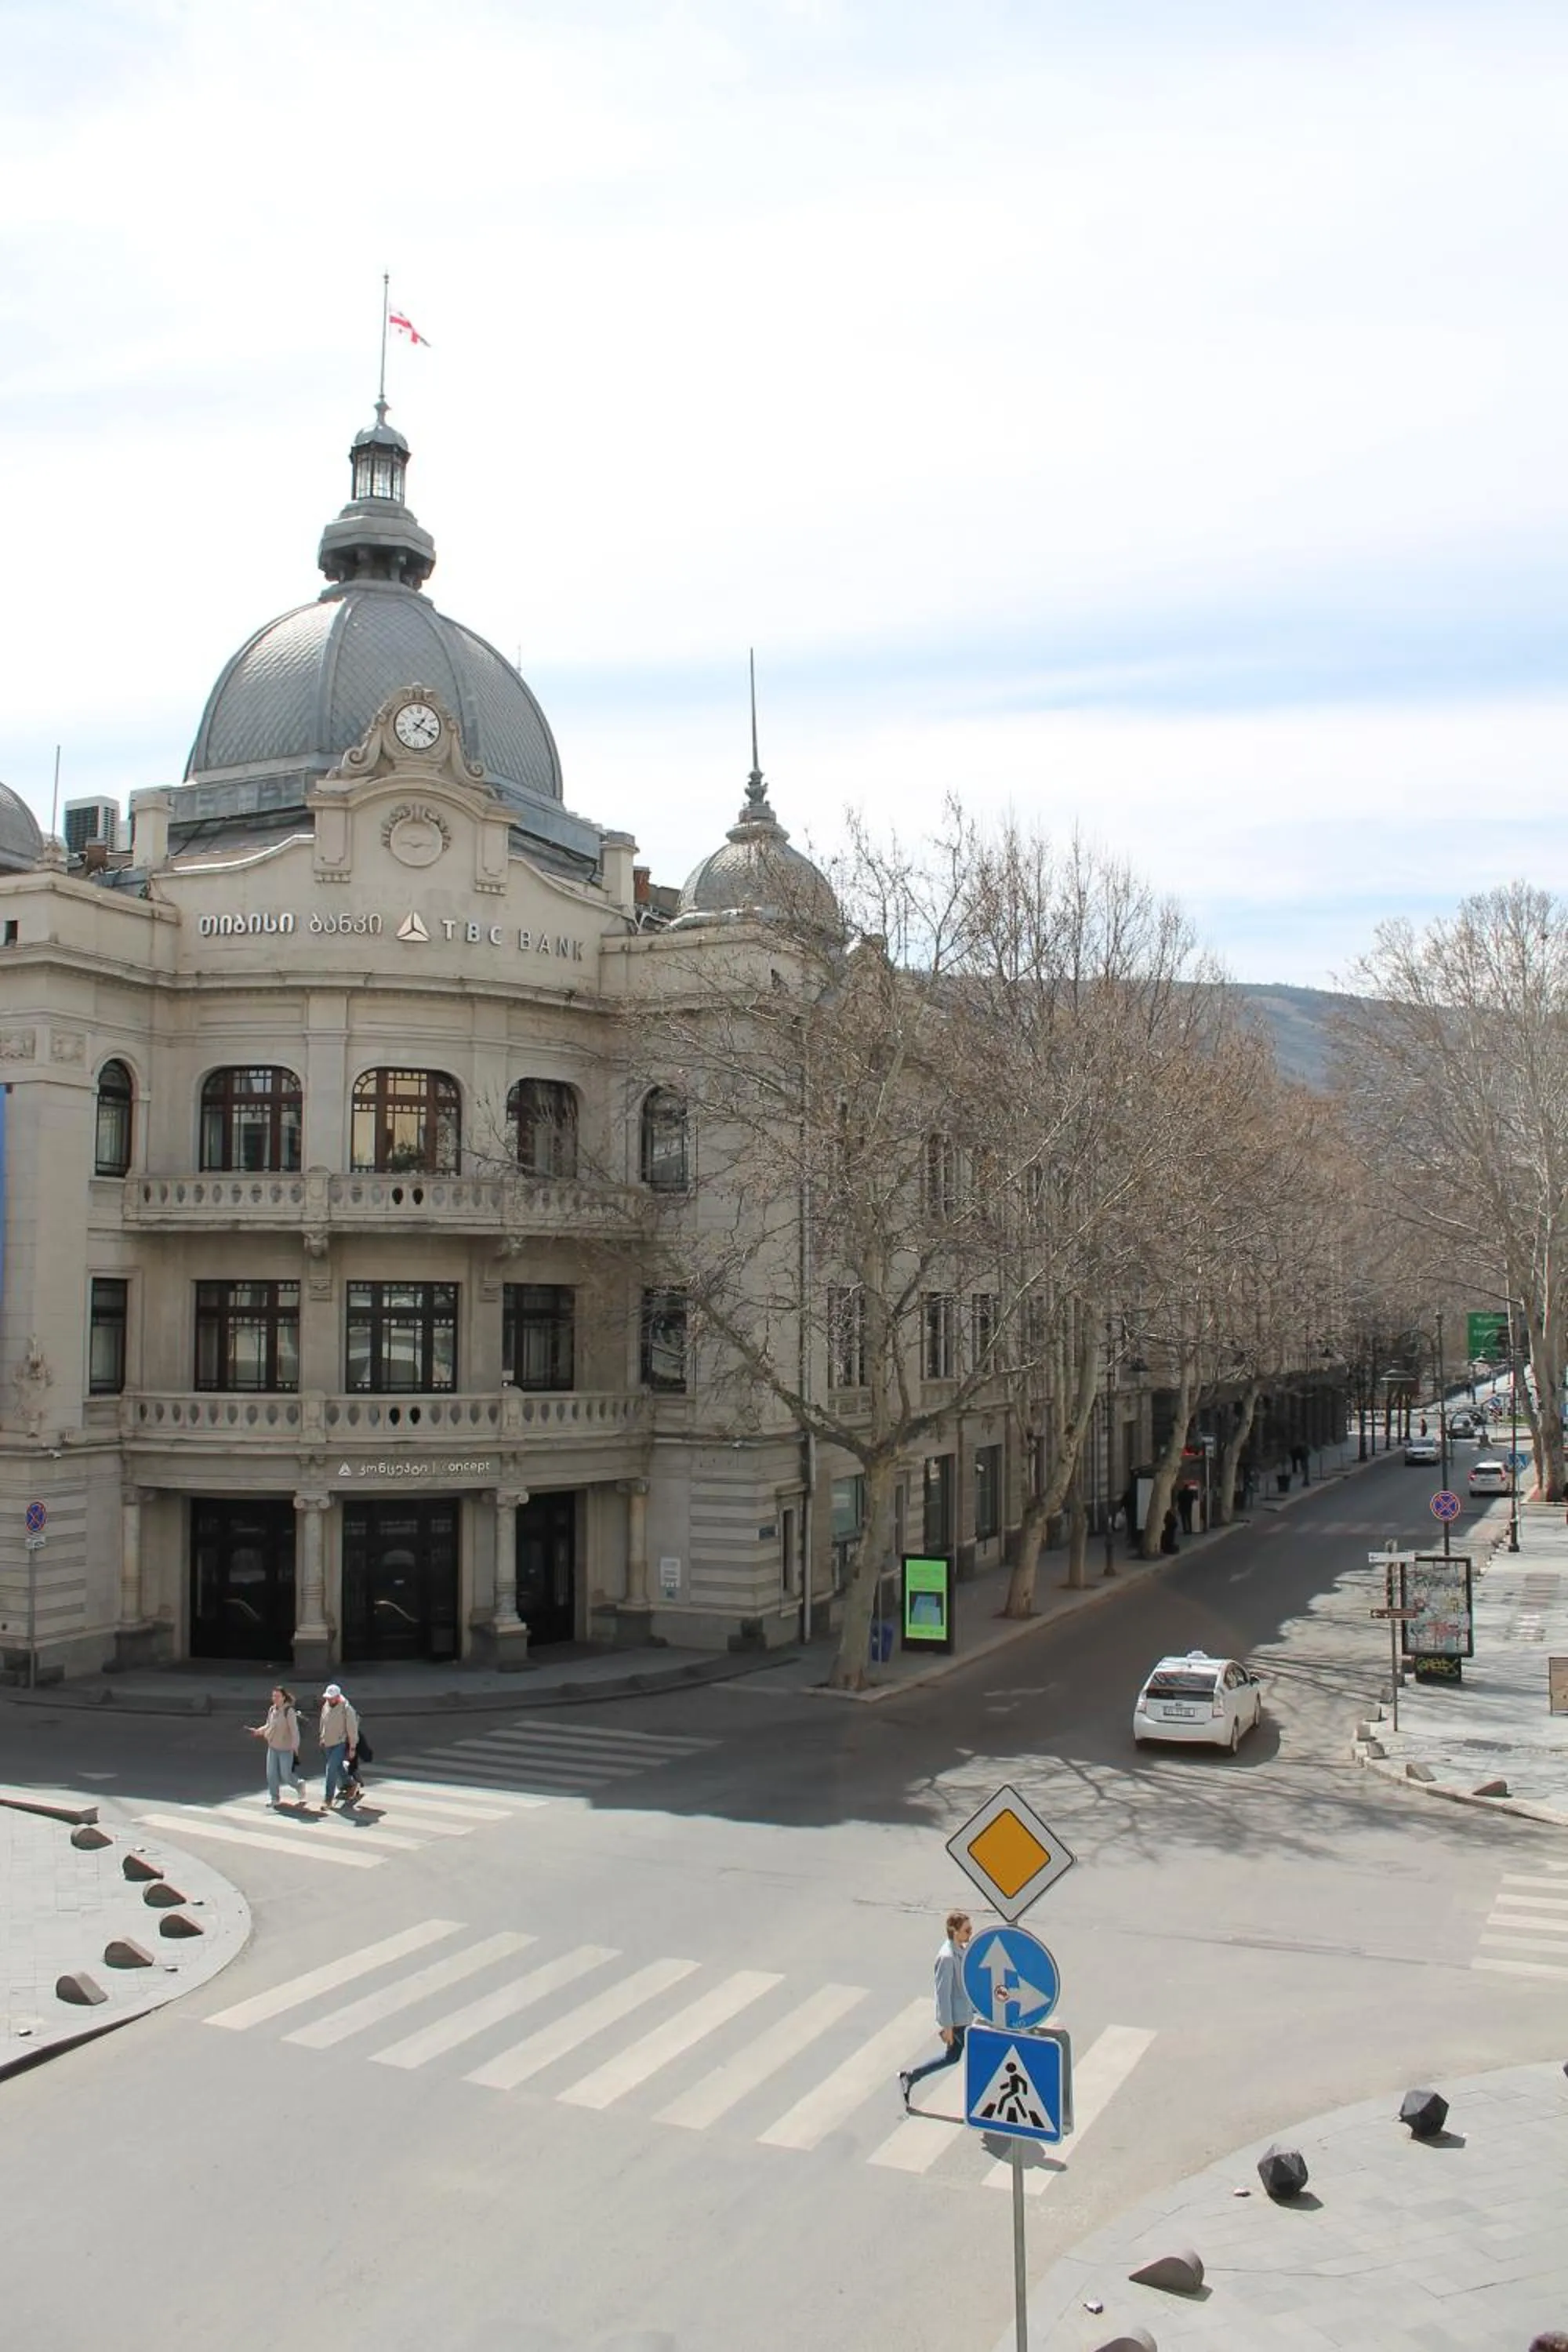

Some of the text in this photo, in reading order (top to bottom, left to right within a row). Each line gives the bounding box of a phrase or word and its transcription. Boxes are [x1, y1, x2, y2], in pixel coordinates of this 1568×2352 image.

[199, 913, 383, 935] თიბისი ბანკი
[441, 920, 585, 962] TBC BANK
